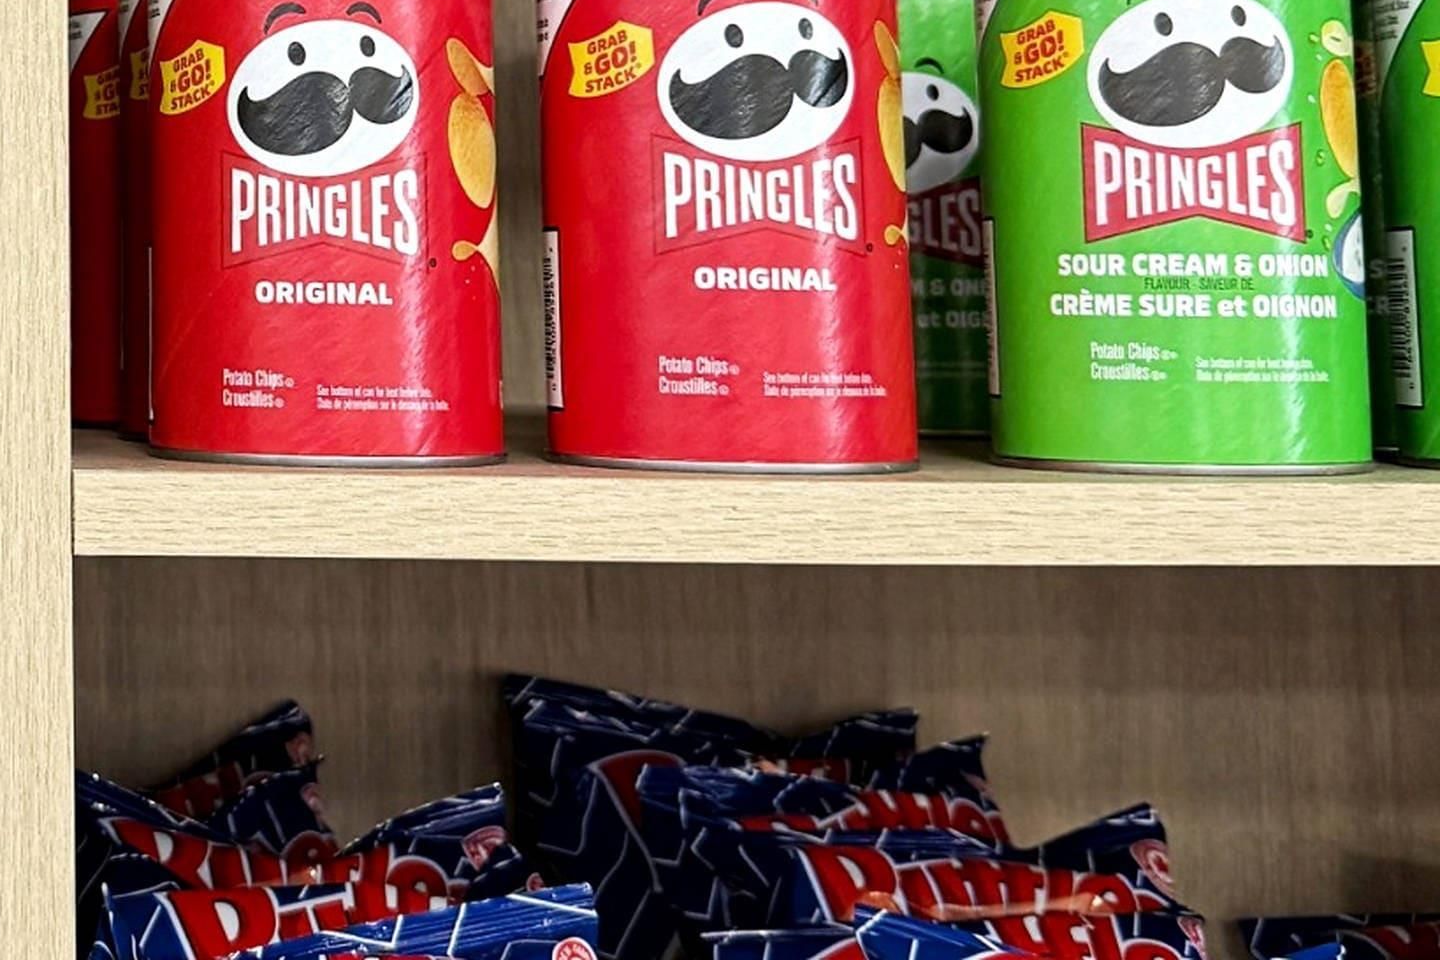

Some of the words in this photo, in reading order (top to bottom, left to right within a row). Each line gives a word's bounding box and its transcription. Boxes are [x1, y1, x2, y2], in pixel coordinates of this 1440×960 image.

[587, 30, 628, 55] GRAB
[1016, 19, 1056, 45] GRAB
[173, 47, 205, 72] GRAB
[594, 40, 637, 76] GO!
[1024, 29, 1065, 65] GO!
[177, 57, 212, 93] GO!
[584, 67, 637, 93] STACK
[1014, 56, 1065, 82] STACK
[170, 84, 210, 111] STACK
[1093, 138, 1297, 226] PRINGLES
[663, 151, 859, 241] PRINGLES
[230, 168, 419, 257] PRINGLES
[1057, 253, 1126, 276] SOUR
[1132, 253, 1228, 276] CREAM
[1234, 253, 1253, 276] &
[1258, 253, 1328, 277] ONION
[693, 266, 837, 291] ORIGINAL
[1144, 277, 1190, 290] FLAVOUR
[1199, 278, 1238, 290] SAVEUR
[1241, 278, 1255, 290] DE
[255, 280, 393, 306] ORIGINAL
[1050, 287, 1133, 316] CRÈME
[1138, 295, 1212, 317] SURE
[1217, 294, 1248, 317] et
[1252, 295, 1338, 318] OIGNON
[1090, 341, 1124, 360] Potato
[1128, 342, 1160, 362] Chips
[658, 355, 693, 374] Potato
[696, 356, 728, 376] Chips
[1090, 362, 1149, 381] Croustilles
[222, 368, 252, 387] Potato
[255, 368, 285, 390] Chips
[658, 376, 717, 396] Croustilles
[222, 389, 274, 408] Croustilles
